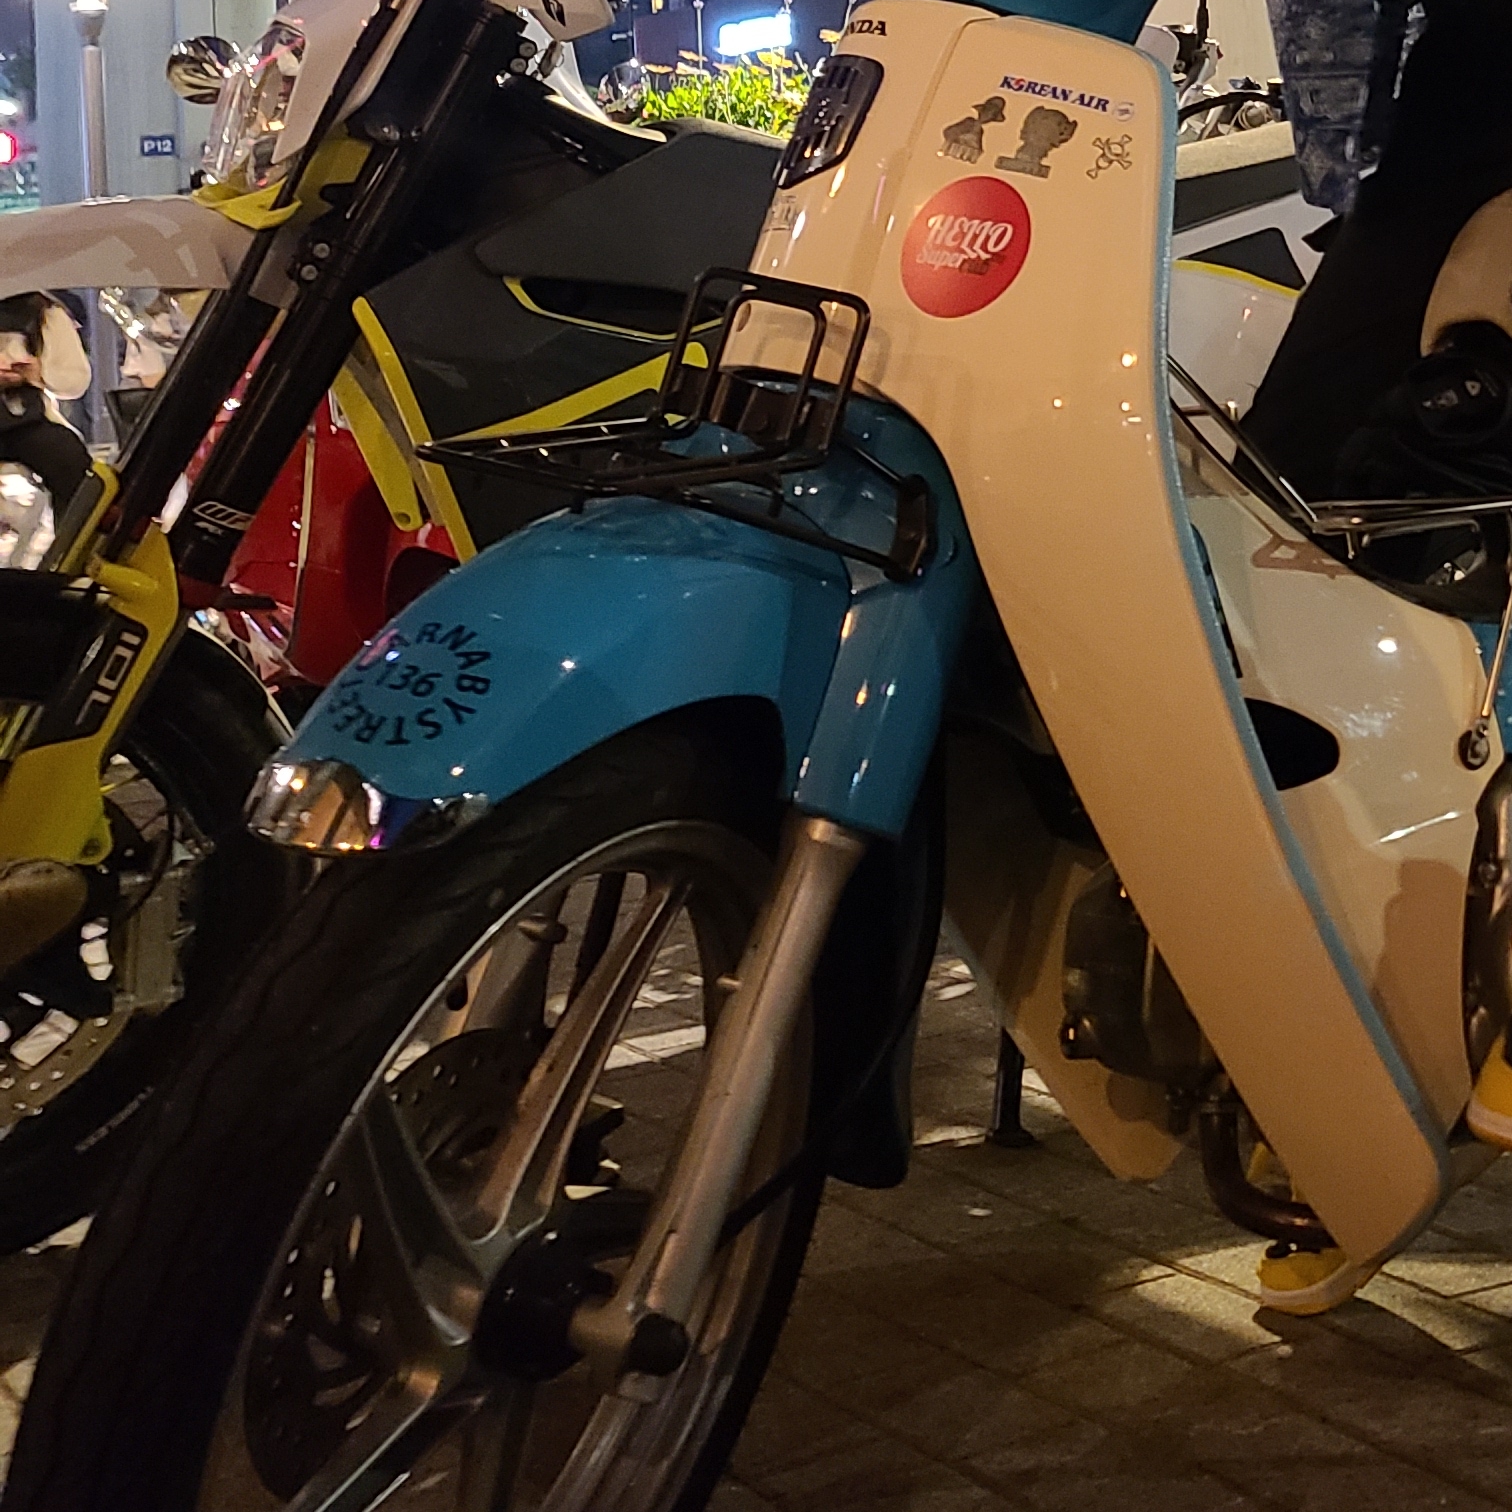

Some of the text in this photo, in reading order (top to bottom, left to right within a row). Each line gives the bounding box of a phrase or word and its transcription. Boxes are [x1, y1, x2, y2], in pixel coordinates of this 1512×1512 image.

[1000, 76, 1073, 101] KOREAN
[1072, 93, 1110, 113] AIR
[143, 139, 173, 153] P12
[925, 214, 1013, 260] HELLO
